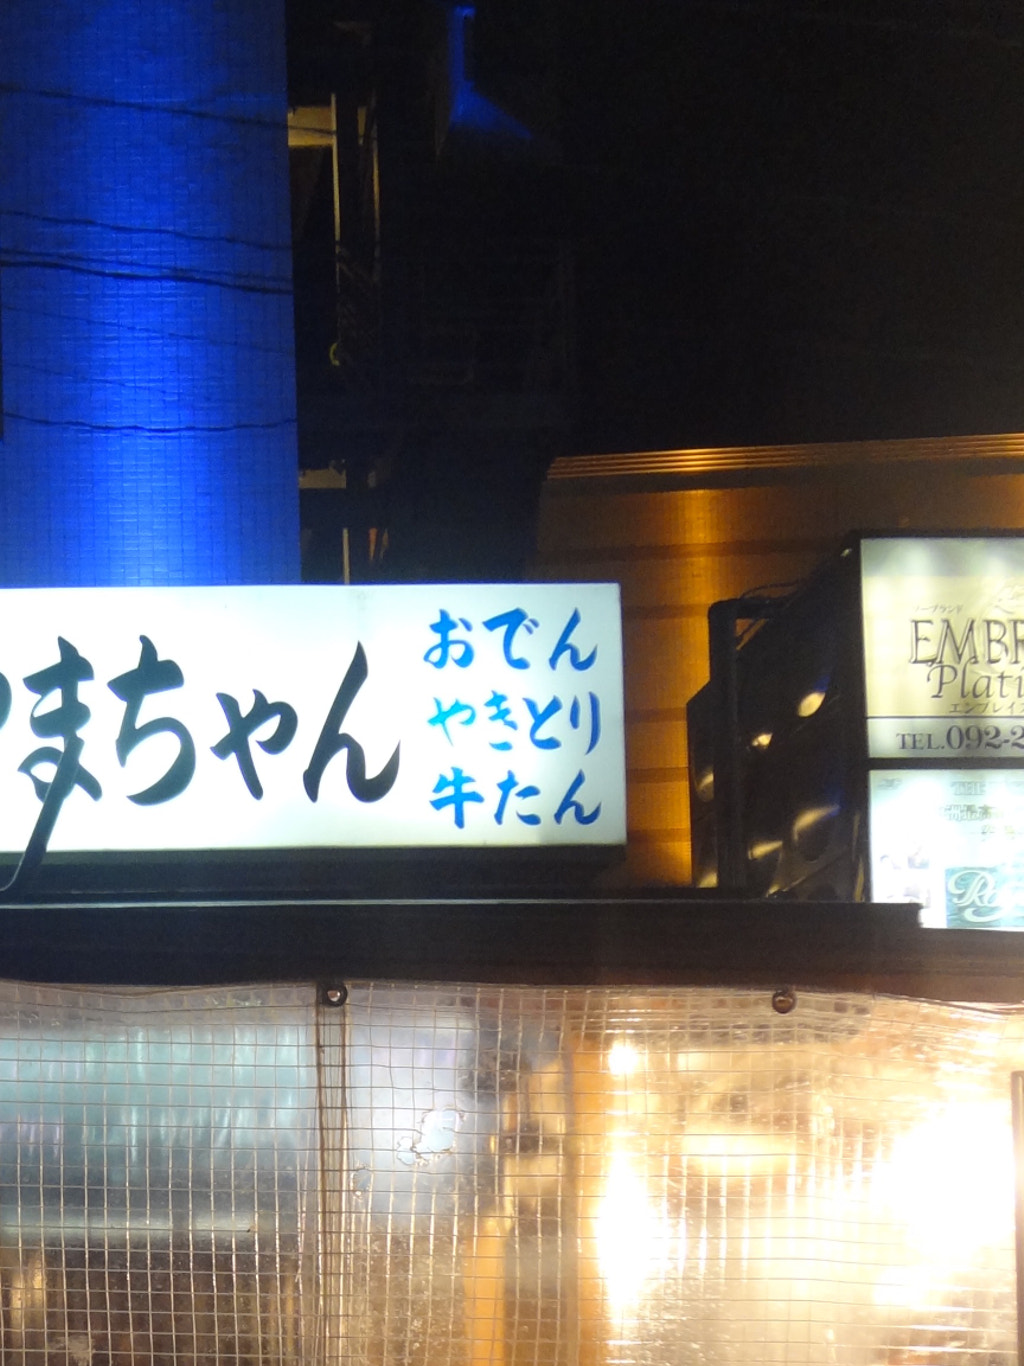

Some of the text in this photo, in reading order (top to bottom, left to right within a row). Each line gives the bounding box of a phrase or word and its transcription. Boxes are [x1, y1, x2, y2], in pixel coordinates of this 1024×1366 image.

[423, 608, 599, 672] おでん
[427, 690, 600, 756] やきとり
[429, 768, 602, 830] 牛たん
